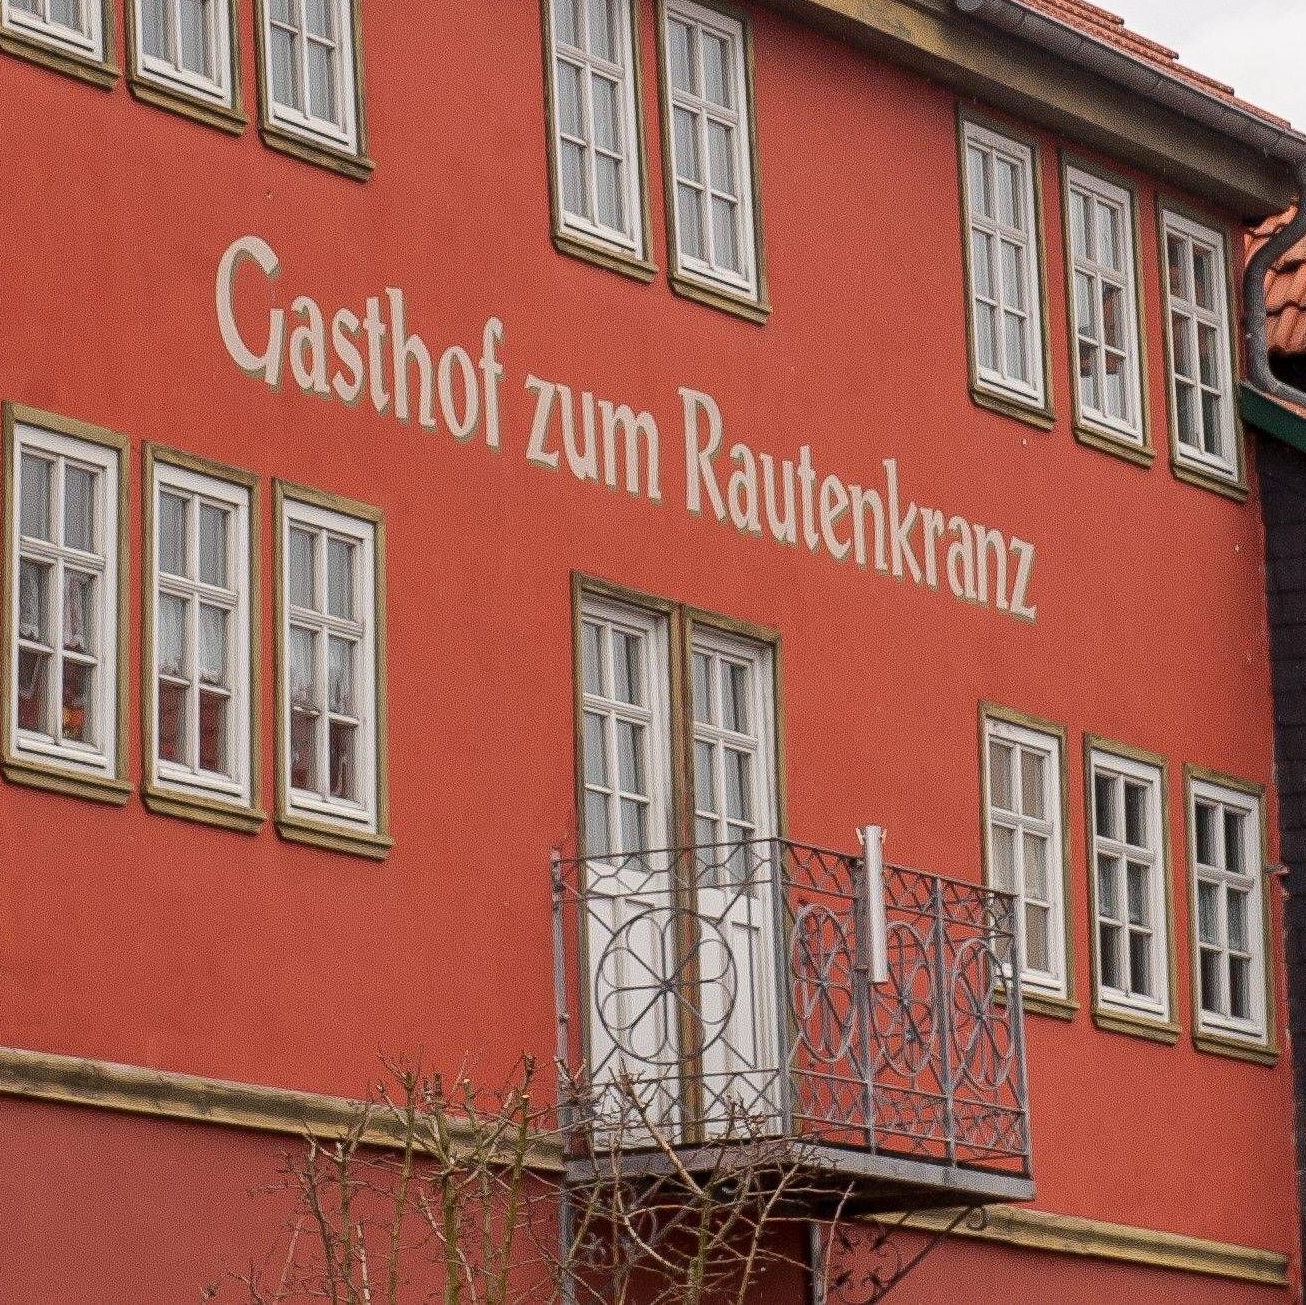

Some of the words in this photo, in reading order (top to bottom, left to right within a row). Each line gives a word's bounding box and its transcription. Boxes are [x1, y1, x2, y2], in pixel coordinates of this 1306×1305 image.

[215, 234, 504, 450] Gasthof
[523, 373, 662, 503] zum
[677, 385, 1038, 624] Rautenkranz
